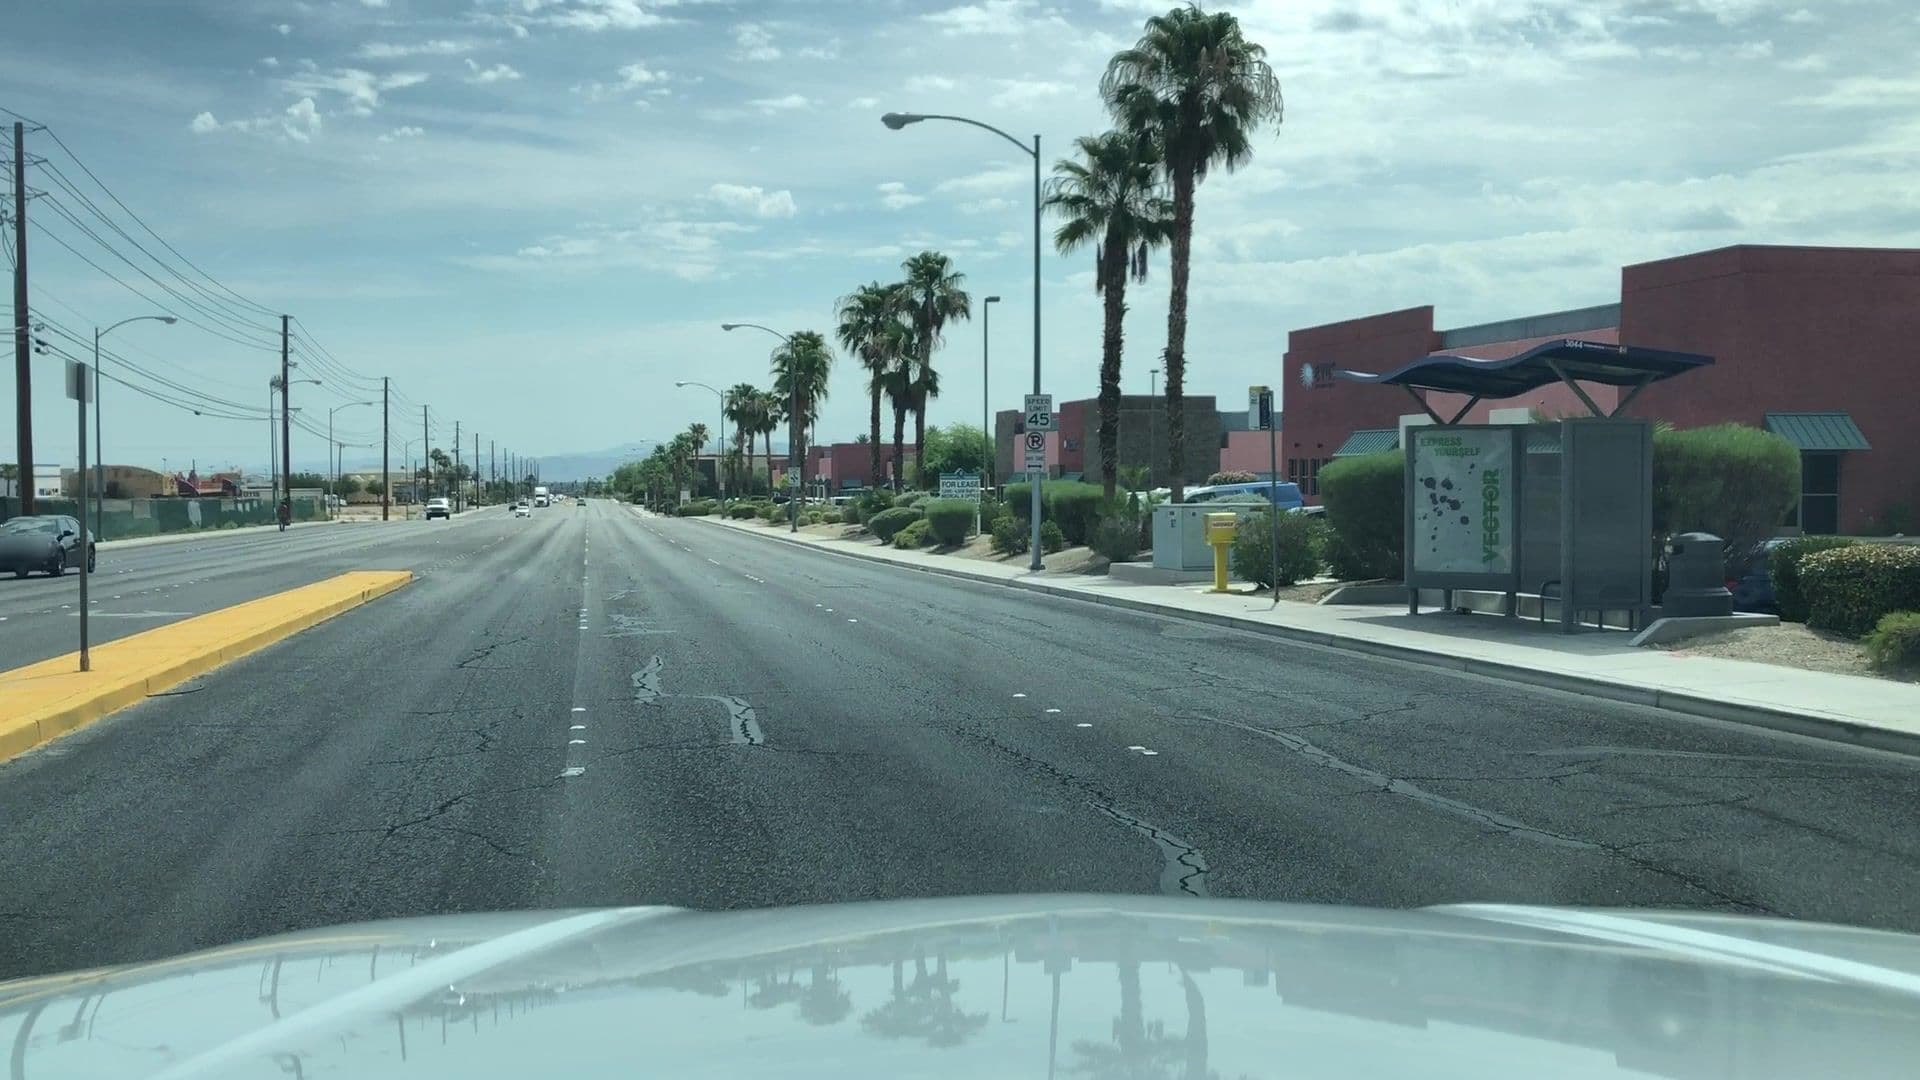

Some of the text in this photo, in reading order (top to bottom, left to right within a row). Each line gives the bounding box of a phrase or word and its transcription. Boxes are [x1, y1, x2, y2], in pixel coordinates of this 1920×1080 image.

[1565, 339, 1583, 349] 3044
[1028, 413, 1050, 426] 45
[1420, 437, 1463, 447] EXPRESS
[1434, 447, 1481, 457] YOURSELF
[1482, 468, 1500, 563] VECTOR
